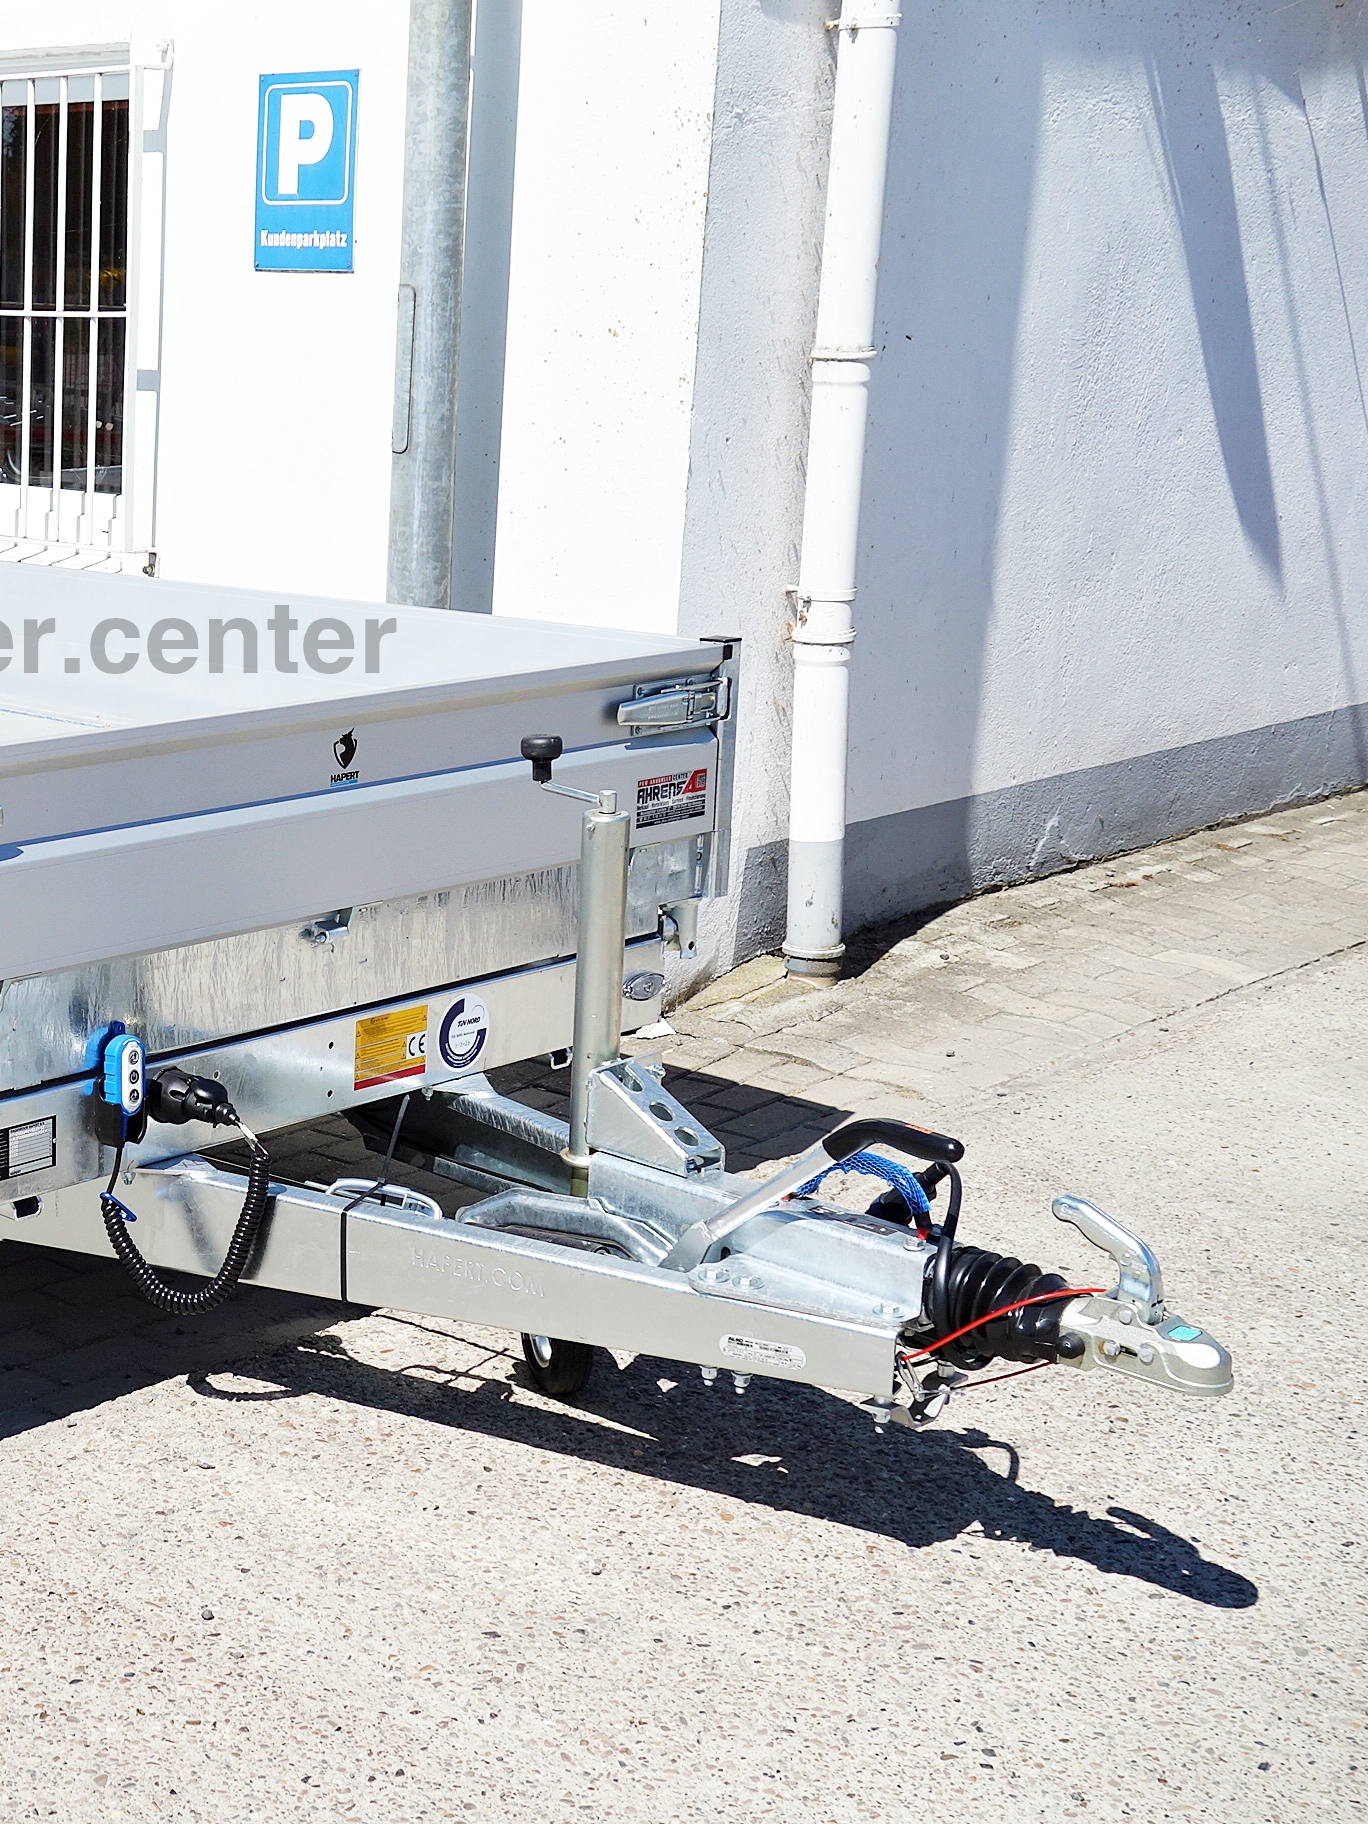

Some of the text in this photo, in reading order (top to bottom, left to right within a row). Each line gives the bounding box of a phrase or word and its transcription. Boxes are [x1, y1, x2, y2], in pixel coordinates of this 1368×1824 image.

[277, 92, 334, 195] P
[260, 230, 347, 249] Kundenparkplatz
[330, 770, 359, 783] HAPERT
[637, 780, 687, 804] AHRENS
[467, 1016, 481, 1025] NORD
[408, 1033, 426, 1056] CE
[411, 1246, 544, 1298] HAPERT.COM
